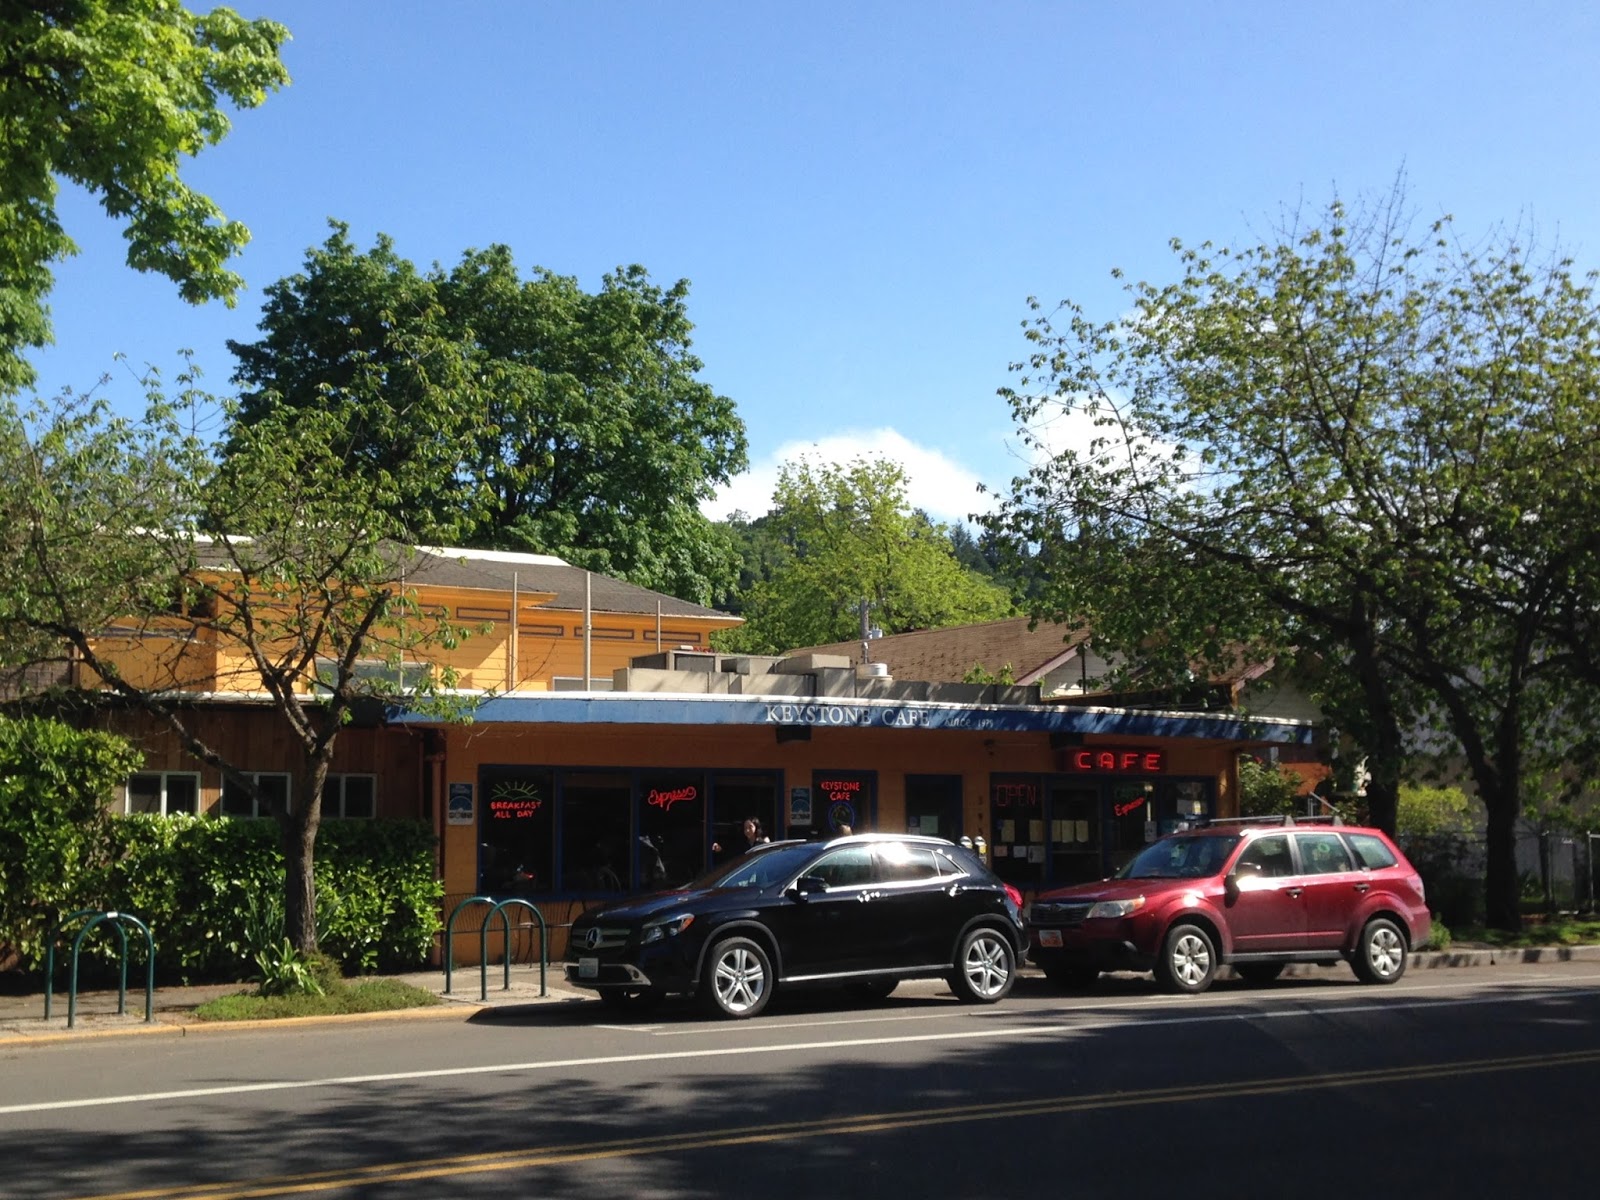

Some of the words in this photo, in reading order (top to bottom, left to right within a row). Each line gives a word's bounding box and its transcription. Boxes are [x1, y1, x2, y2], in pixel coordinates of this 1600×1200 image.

[765, 704, 872, 725] KEYSTONE
[881, 708, 930, 727] CAFE
[1075, 752, 1161, 769] CAFE
[821, 781, 861, 791] KEYSTONE
[829, 791, 850, 801] CAFE
[995, 783, 1037, 807] OPEN
[490, 800, 542, 810] BREAKFAST
[493, 809, 512, 819] ALL
[516, 809, 534, 818] DAY
